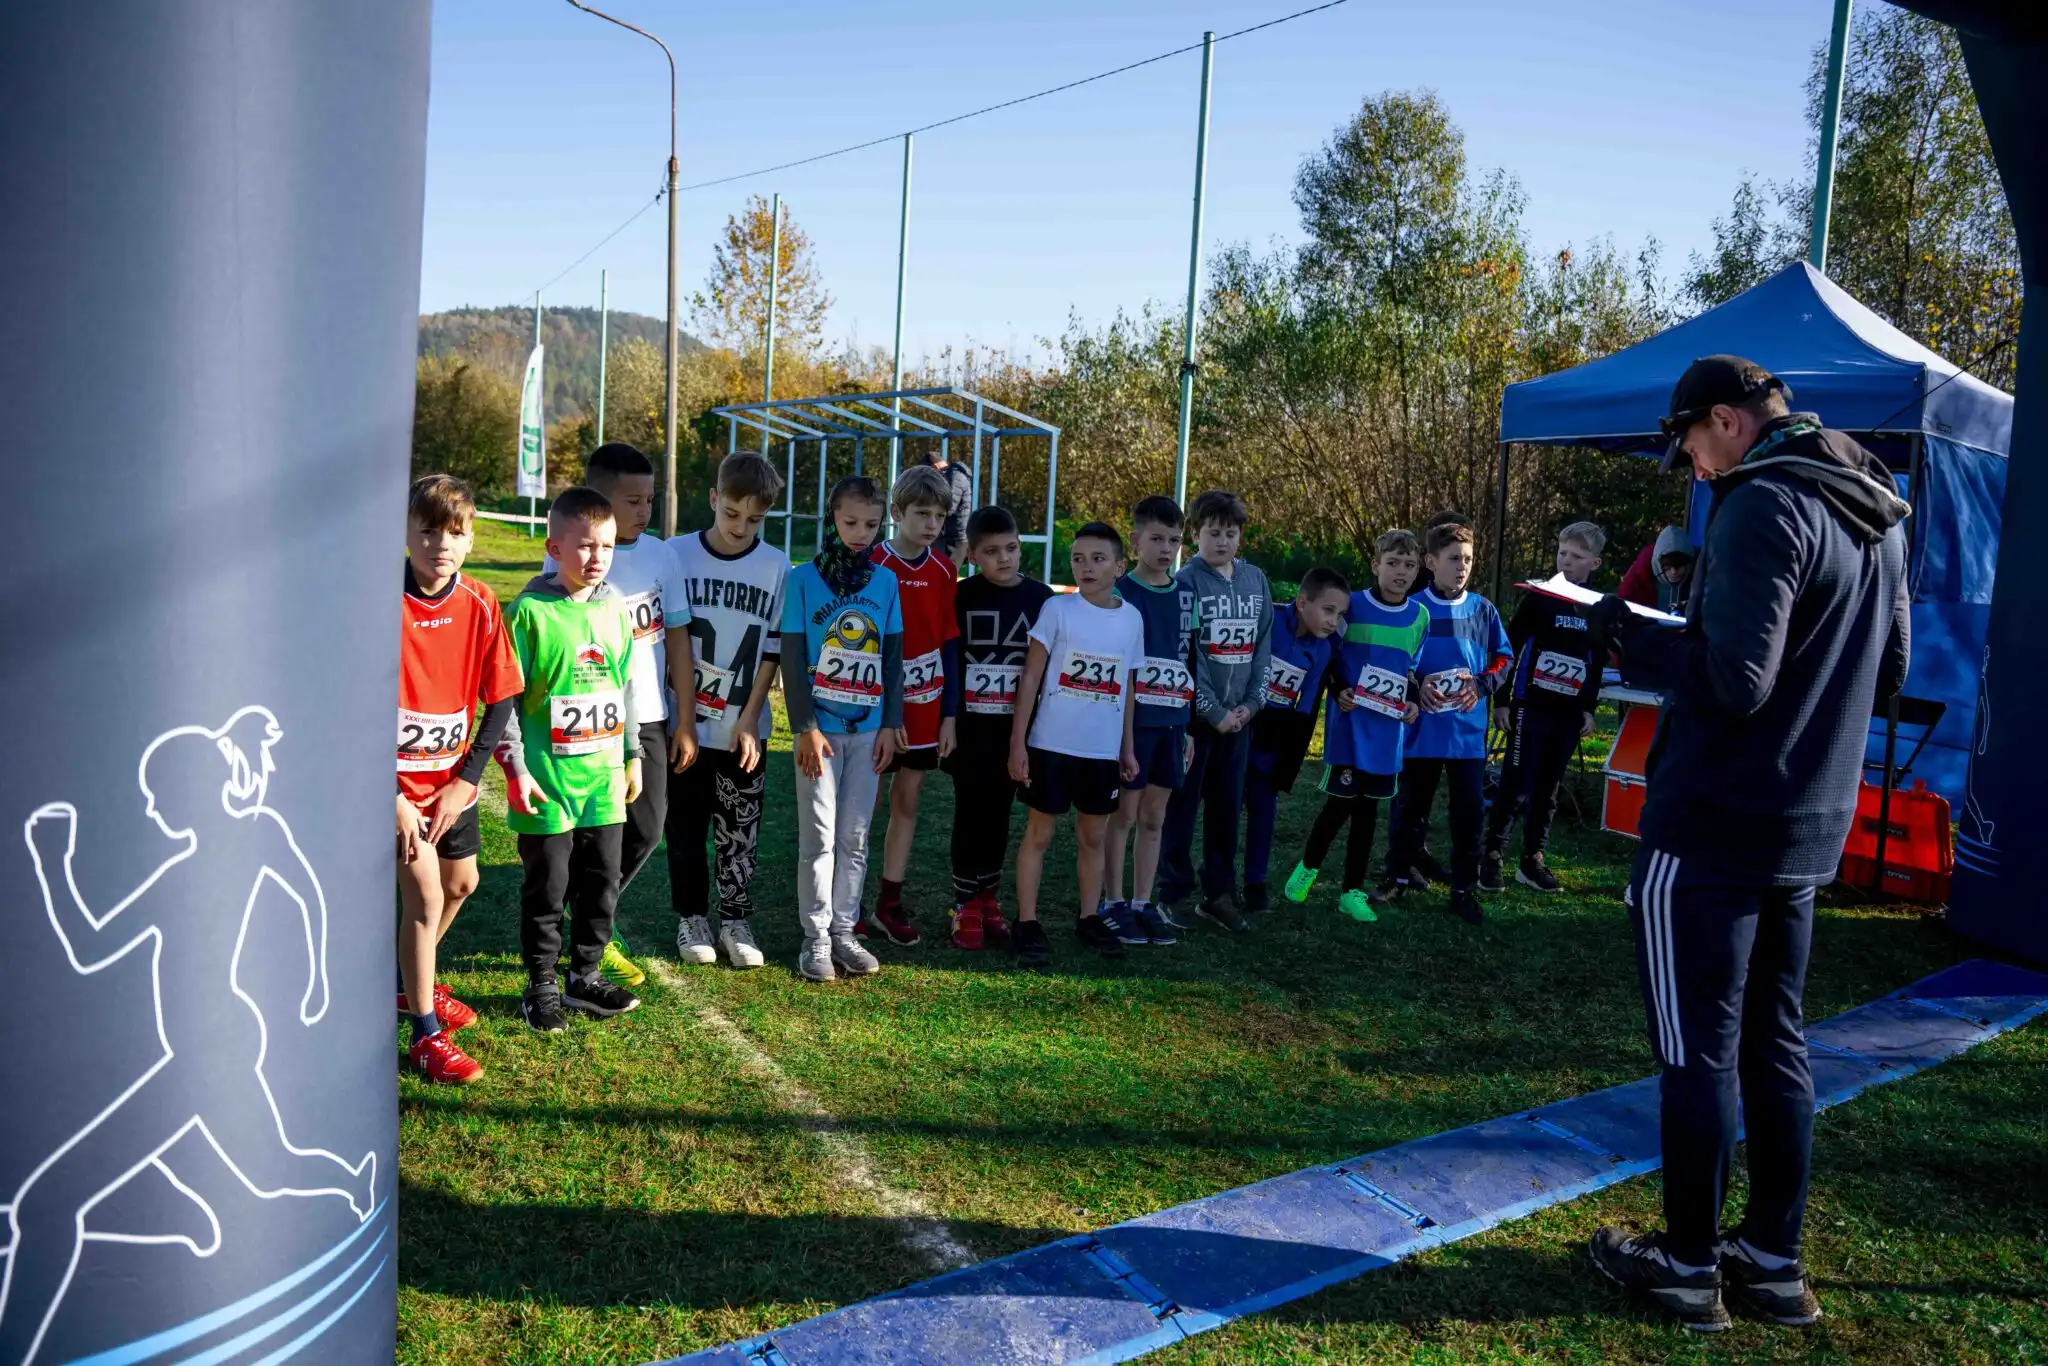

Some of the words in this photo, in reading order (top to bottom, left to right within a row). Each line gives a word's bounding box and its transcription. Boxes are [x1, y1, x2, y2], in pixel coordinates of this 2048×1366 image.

[629, 597, 664, 632] 03
[1217, 628, 1255, 650] 251
[824, 657, 877, 690] 210
[904, 661, 937, 691] 37
[1069, 659, 1116, 689] 231
[1144, 666, 1189, 694] 232
[1542, 659, 1582, 680] 227
[975, 673, 1020, 699] 211
[1364, 674, 1405, 704] 223
[562, 702, 618, 737] 218
[397, 721, 463, 754] 238
